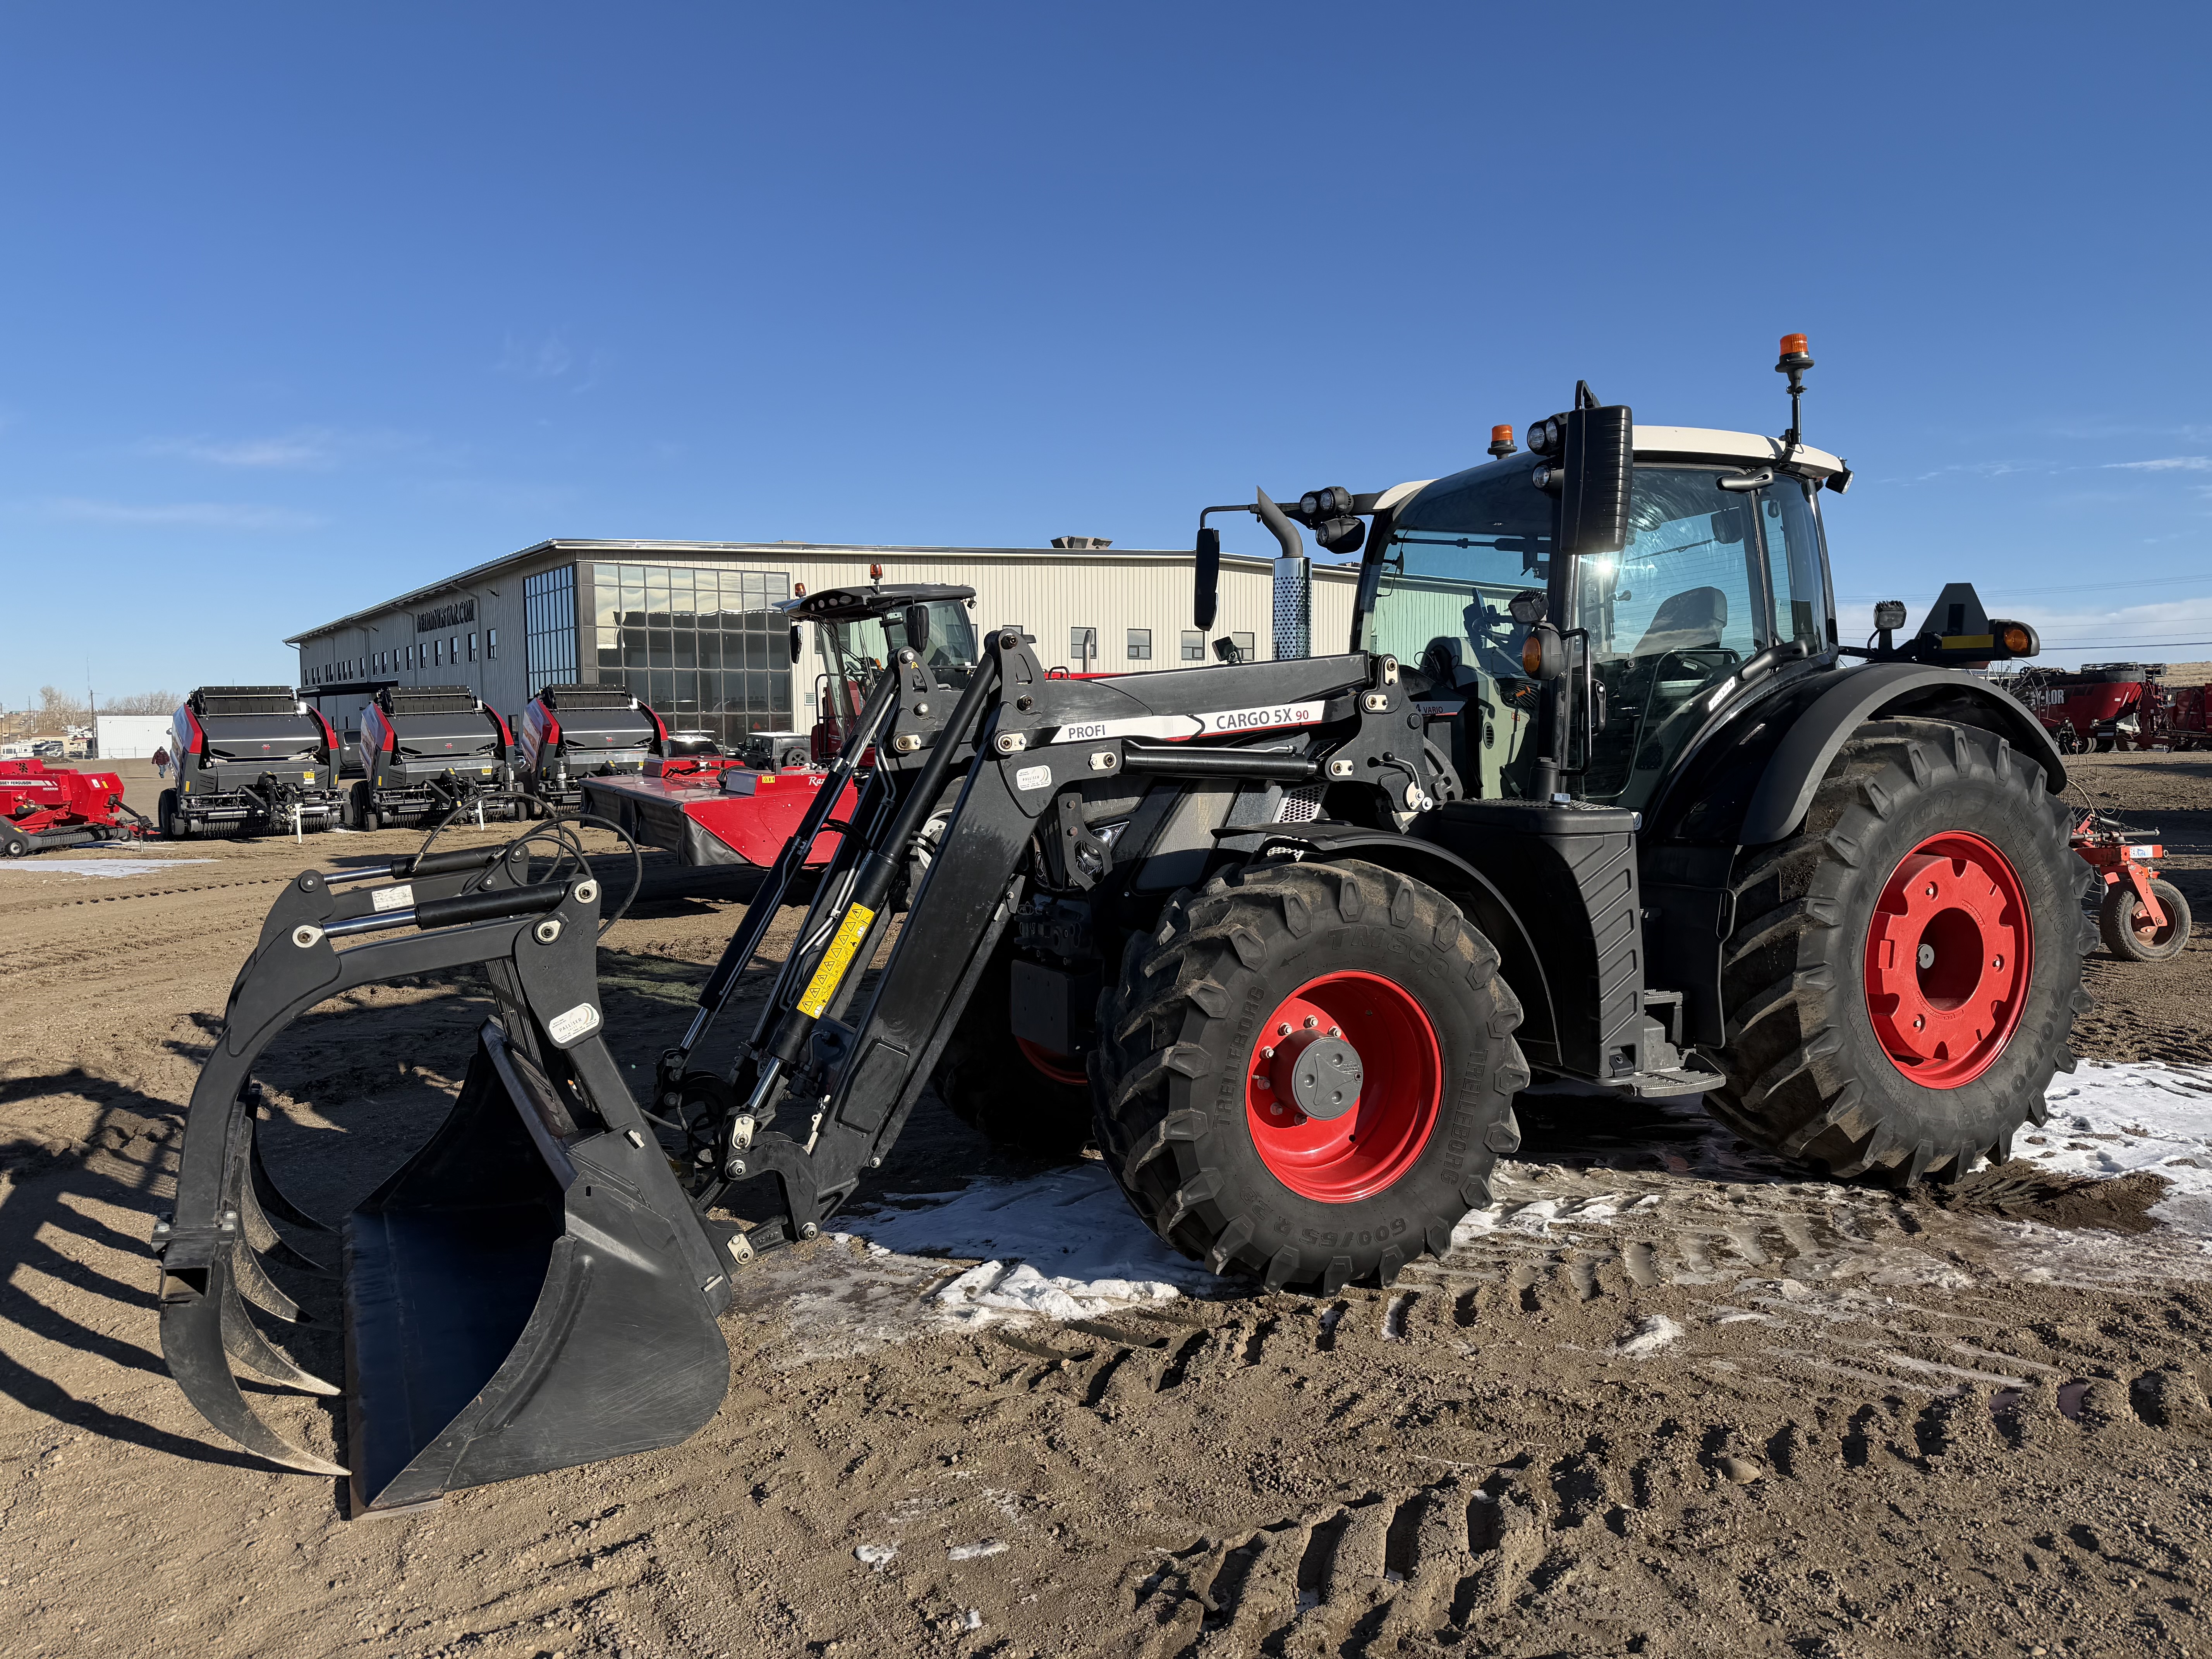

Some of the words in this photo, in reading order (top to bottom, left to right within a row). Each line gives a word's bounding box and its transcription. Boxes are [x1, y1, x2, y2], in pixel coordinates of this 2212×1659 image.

[1068, 725, 1105, 738] PROFI
[1217, 711, 1269, 730] CARGO
[1274, 708, 1292, 723] 5X
[1295, 710, 1309, 721] 90
[2002, 798, 2071, 935] TRELLEBORG
[559, 1018, 582, 1032] PALLISER
[1213, 986, 1264, 1129] TRELLEBORG
[1843, 990, 1917, 1129] TRELLEBORG
[1441, 1049, 1489, 1185] TRELLEBORG
[1299, 1217, 1407, 1249] 600/65
